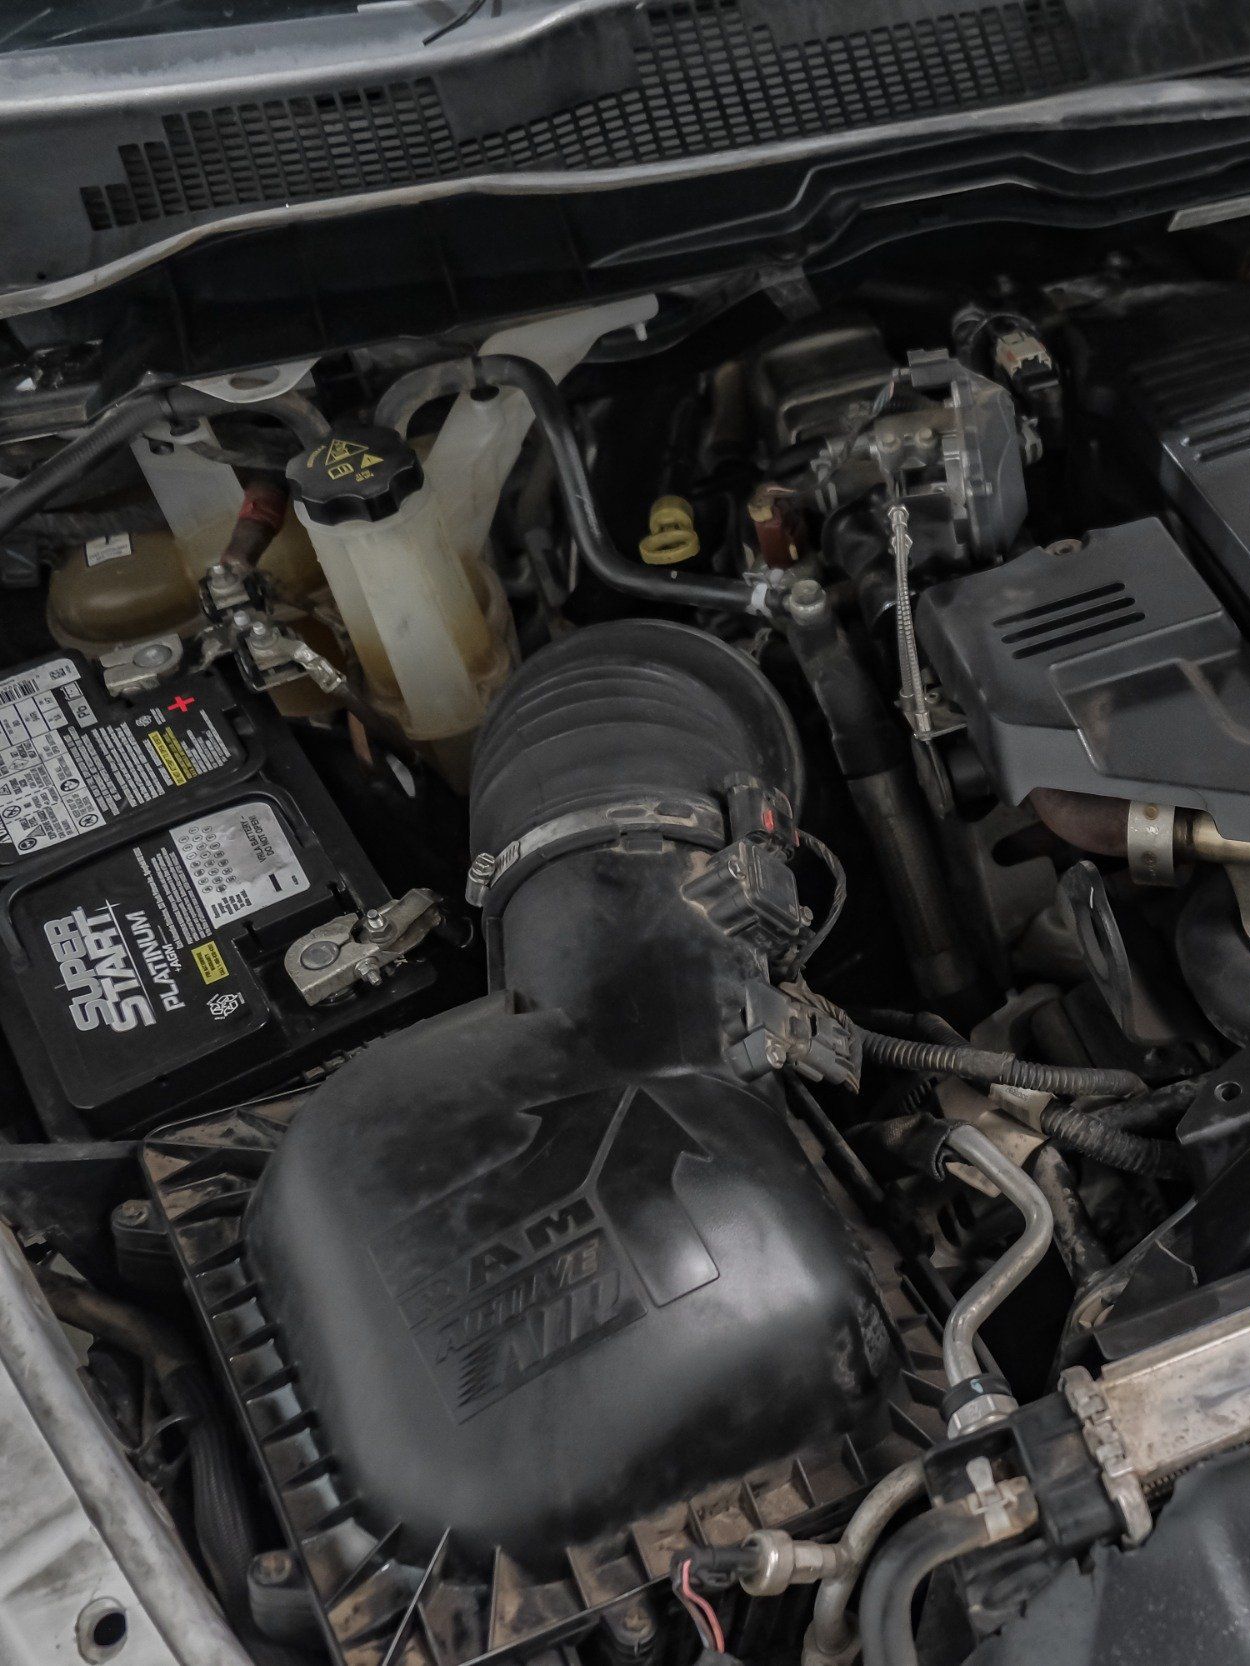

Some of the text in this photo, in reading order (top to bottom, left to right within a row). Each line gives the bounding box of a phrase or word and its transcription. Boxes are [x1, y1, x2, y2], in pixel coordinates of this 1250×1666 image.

[75, 704, 89, 718] Pb
[240, 819, 258, 846] BATTERY
[258, 832, 269, 846] NOT
[252, 844, 267, 863] VRLA
[264, 845, 274, 856] DO
[44, 914, 100, 1031] SUPER
[71, 906, 155, 1032] START
[125, 910, 186, 1012] PLATINUM
